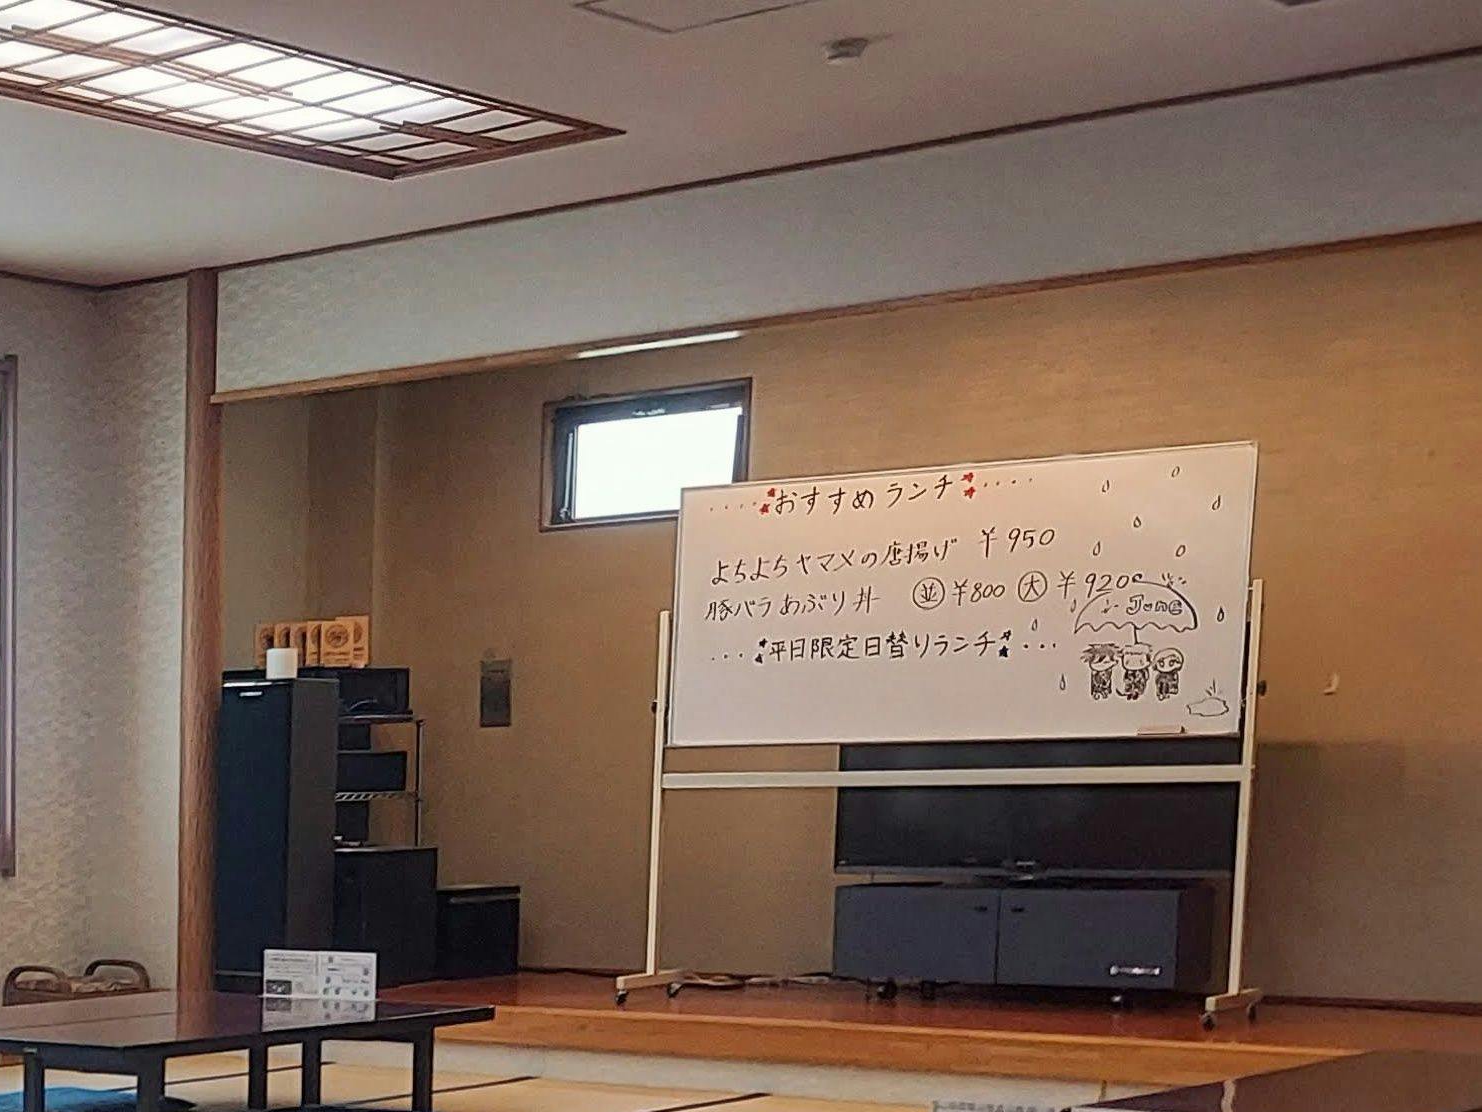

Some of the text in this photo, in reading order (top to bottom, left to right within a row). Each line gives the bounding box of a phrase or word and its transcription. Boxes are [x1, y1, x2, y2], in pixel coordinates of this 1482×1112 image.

[769, 630, 996, 661] 平日限定日替りランチ
